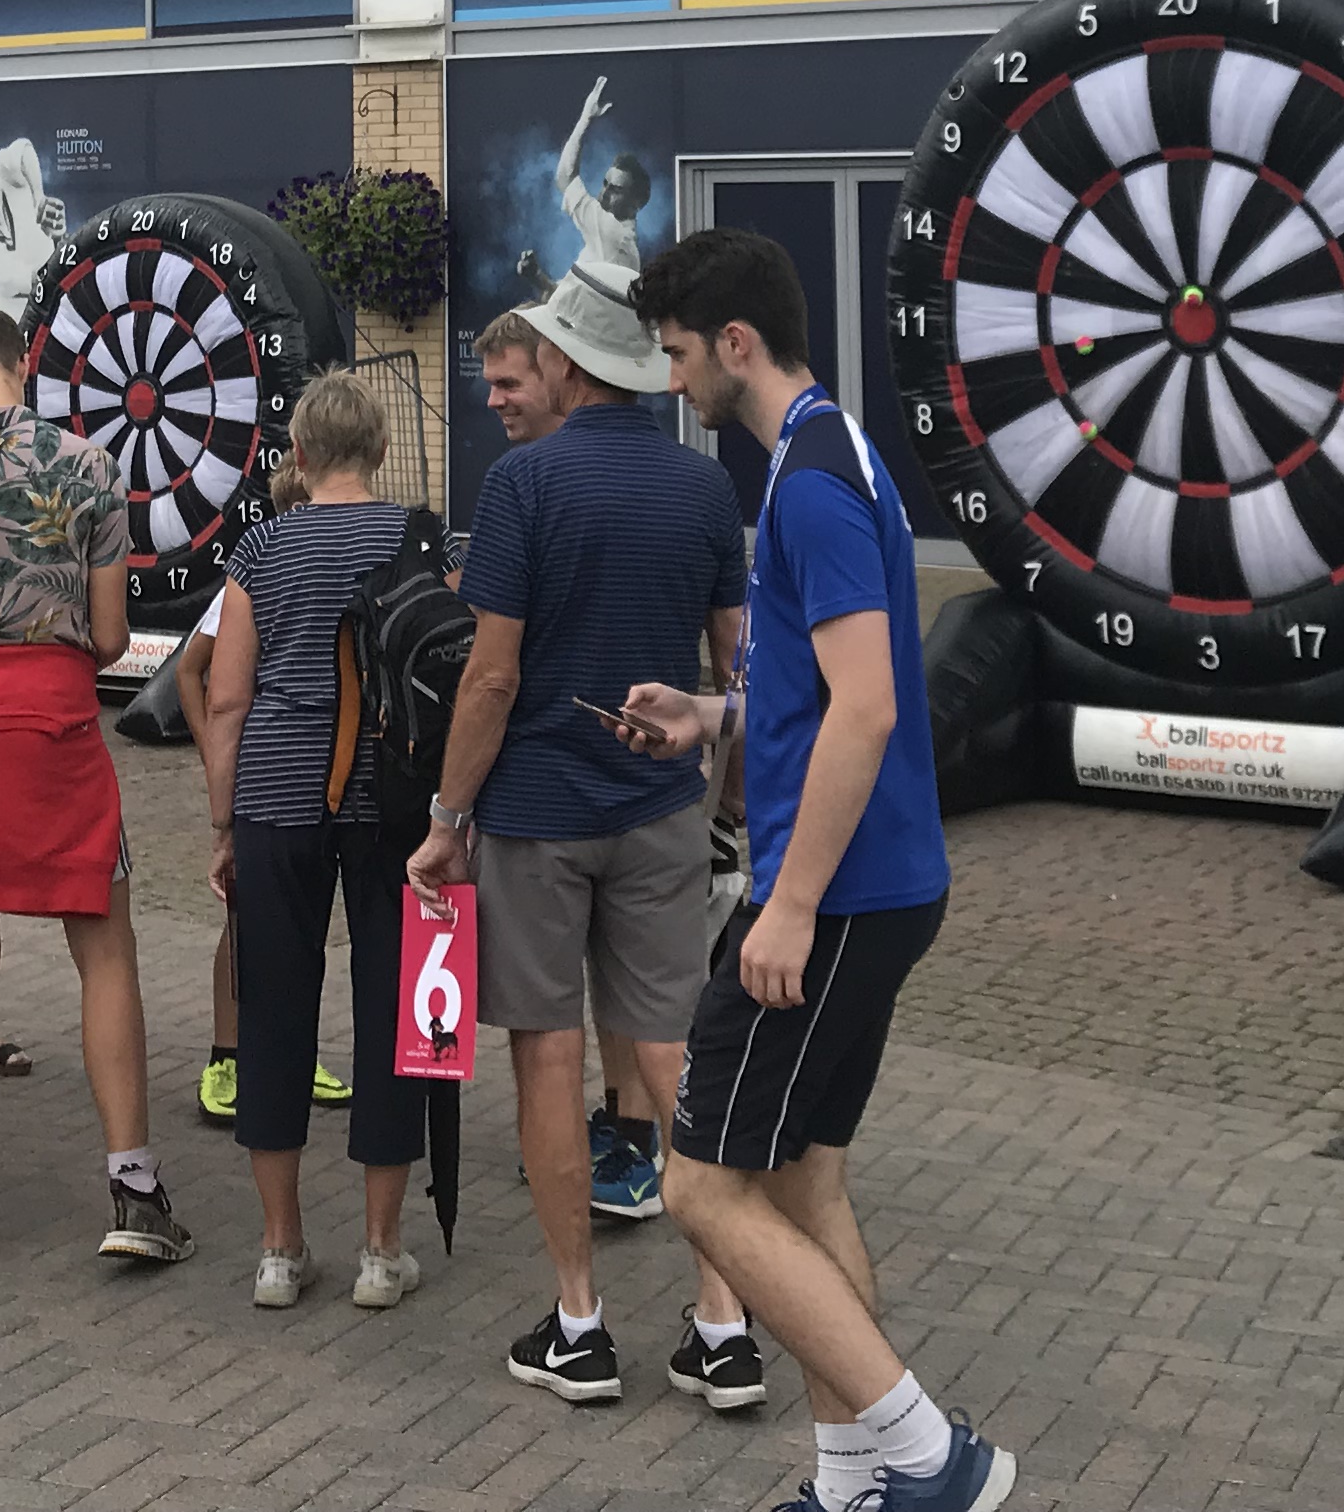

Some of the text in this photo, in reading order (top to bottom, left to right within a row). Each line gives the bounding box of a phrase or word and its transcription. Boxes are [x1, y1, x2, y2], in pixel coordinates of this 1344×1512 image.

[1078, 5, 1098, 37] 5
[993, 53, 1028, 85] 12
[57, 140, 103, 154] HUTTON
[943, 123, 961, 153] 9
[97, 219, 109, 240] 5
[131, 211, 154, 232] 20
[179, 219, 188, 239] 1
[902, 210, 935, 241] 14
[59, 245, 77, 265] 12
[210, 243, 233, 265] 18
[35, 282, 44, 304] 9
[243, 283, 256, 305] 4
[896, 307, 927, 336] 11
[458, 330, 475, 339] RAY
[259, 336, 282, 356] 13
[916, 405, 933, 434] 8
[258, 450, 283, 470] 10
[238, 501, 263, 522] 15
[953, 493, 987, 523] 16
[212, 543, 225, 565] 2
[130, 574, 142, 596] 3
[168, 568, 190, 589] 17
[1024, 562, 1041, 591] 7
[1095, 613, 1135, 646] 19
[1287, 625, 1327, 659] 17
[1199, 637, 1220, 670] 3
[1168, 723, 1286, 755] ballsportz
[1079, 765, 1110, 782] call
[413, 933, 462, 1042] 6
